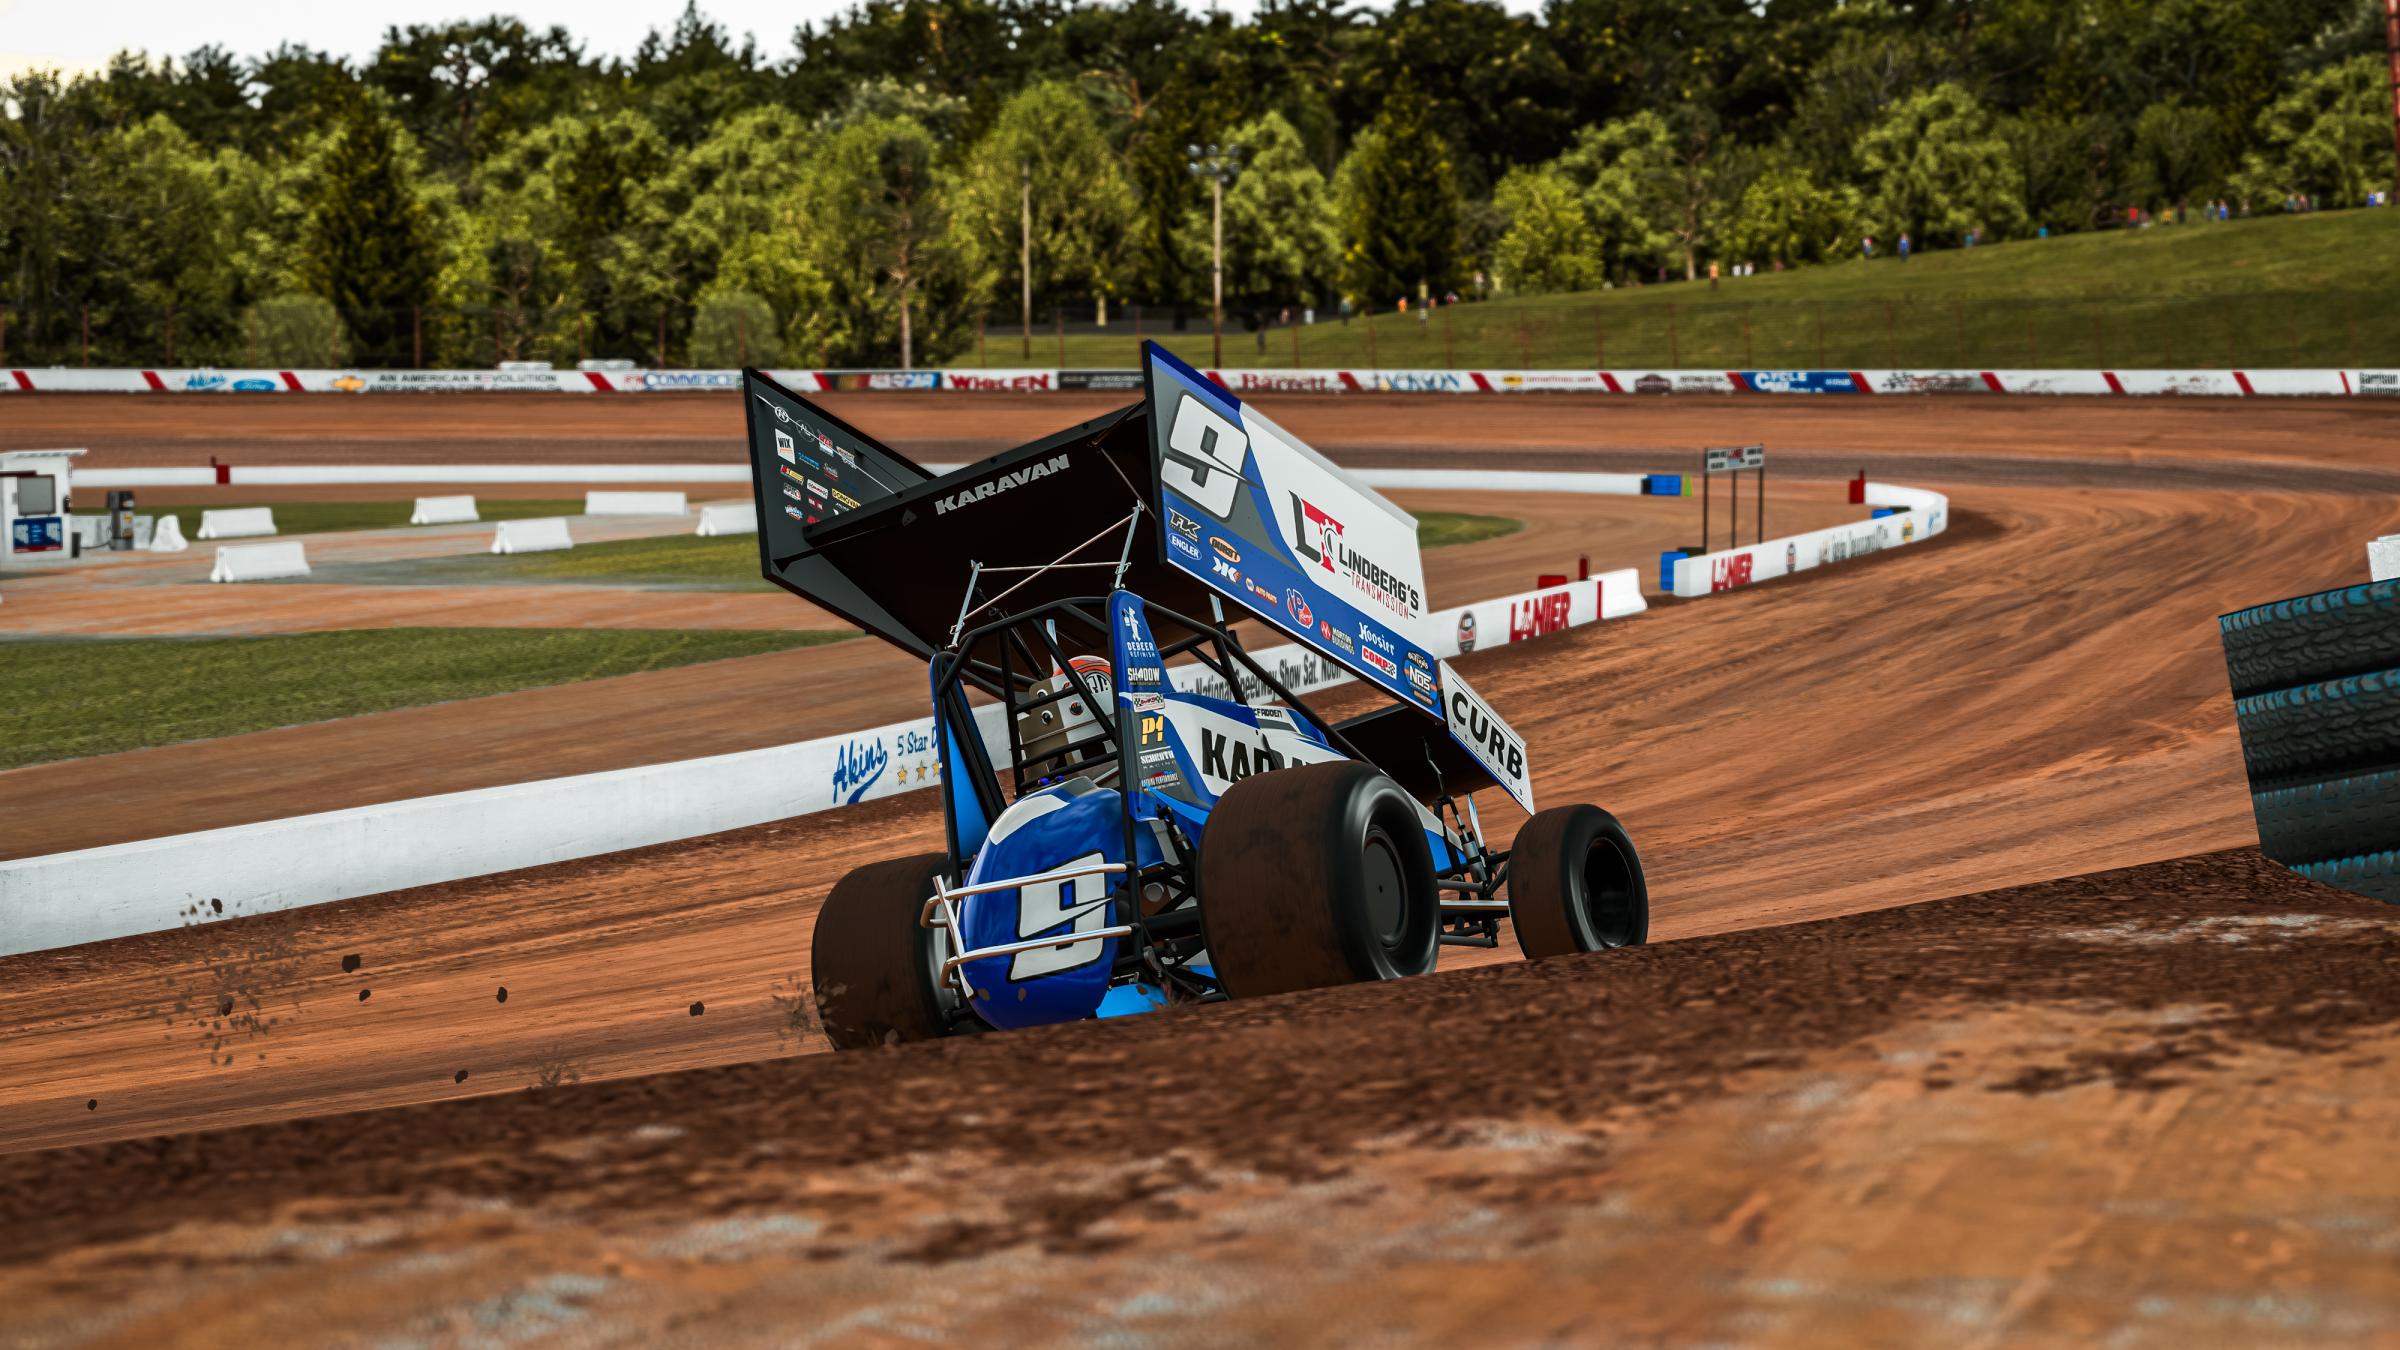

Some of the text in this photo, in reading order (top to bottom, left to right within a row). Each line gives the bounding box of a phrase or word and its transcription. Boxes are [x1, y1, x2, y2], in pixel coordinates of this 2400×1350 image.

[401, 374, 469, 382] AMERICAN
[474, 374, 557, 382] REVOLUTION
[949, 374, 1049, 390] WHELEN
[1241, 373, 1326, 391] Barrett
[1160, 392, 1248, 519] 9
[935, 453, 1070, 515] KARAVAN
[1171, 534, 1199, 559] ENGLER
[1339, 543, 1419, 611] LINDBERG'S
[1711, 553, 1754, 592] LANIER
[1350, 571, 1409, 620] TRANSMISSION
[1509, 591, 1572, 645] LANIER
[1126, 641, 1154, 652] DEBEER
[1358, 621, 1395, 656] Hoosier
[1127, 667, 1160, 682] SHADOW
[1279, 659, 1301, 692] Show
[1303, 653, 1318, 687] Sat.
[1363, 647, 1389, 669] COMP
[1409, 664, 1432, 691] NOS
[897, 734, 905, 757] 5
[907, 731, 928, 754] Star
[1141, 714, 1164, 745] P1
[1451, 691, 1523, 780] CURB
[833, 736, 888, 804] Akins
[1140, 750, 1175, 764] SCHROTH
[1010, 851, 1113, 982] 9
